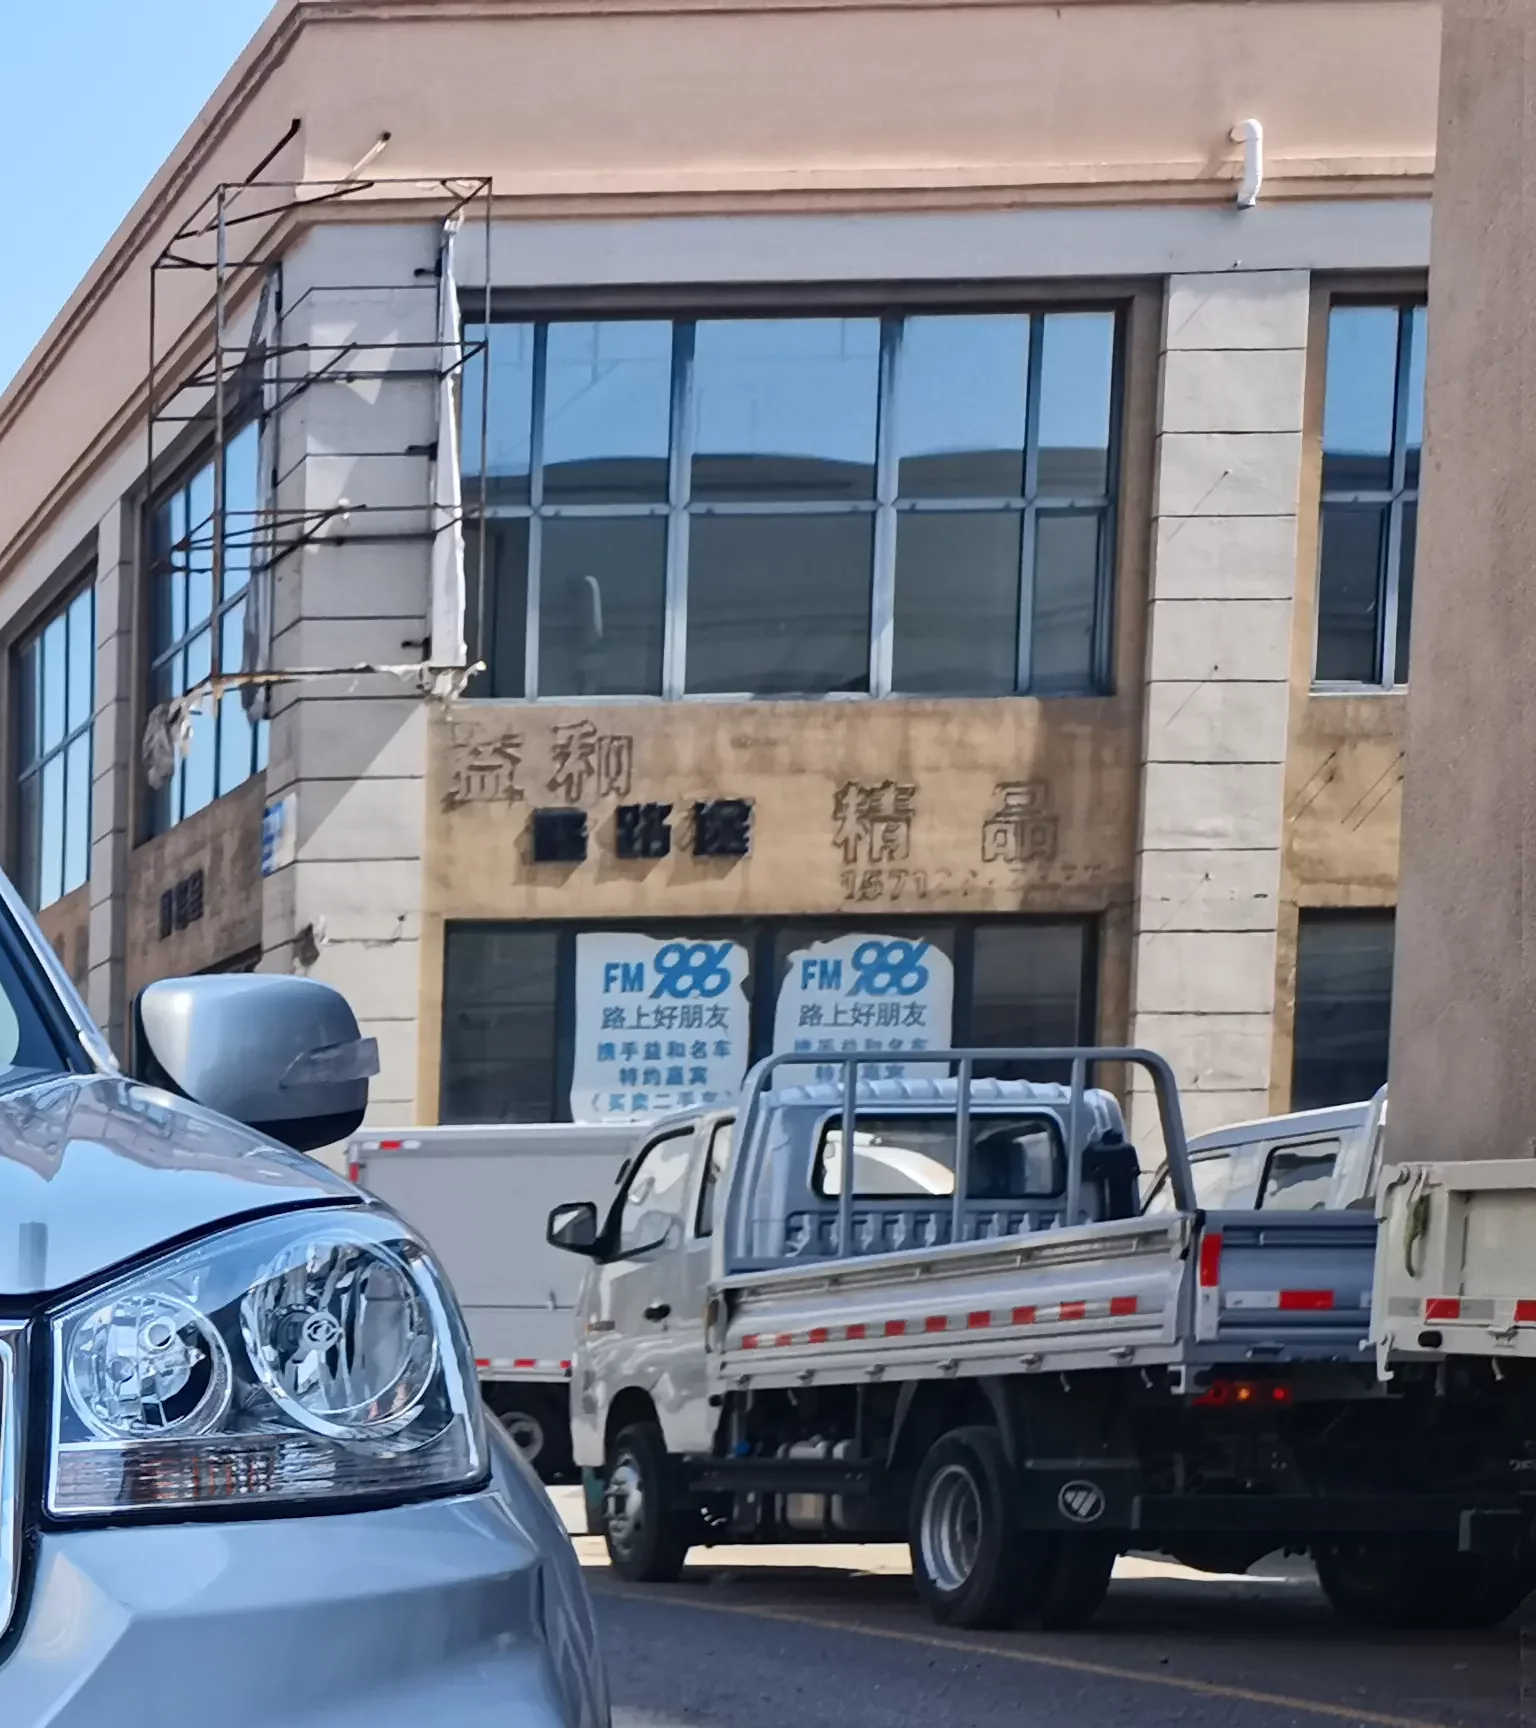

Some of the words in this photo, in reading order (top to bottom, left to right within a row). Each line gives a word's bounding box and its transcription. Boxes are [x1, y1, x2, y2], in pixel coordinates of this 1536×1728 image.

[831, 779, 1059, 863] 精品
[603, 962, 645, 993] FM
[800, 959, 842, 990] FM
[601, 1003, 731, 1031] 路上好朋友
[798, 1001, 927, 1028] 路上好朋友
